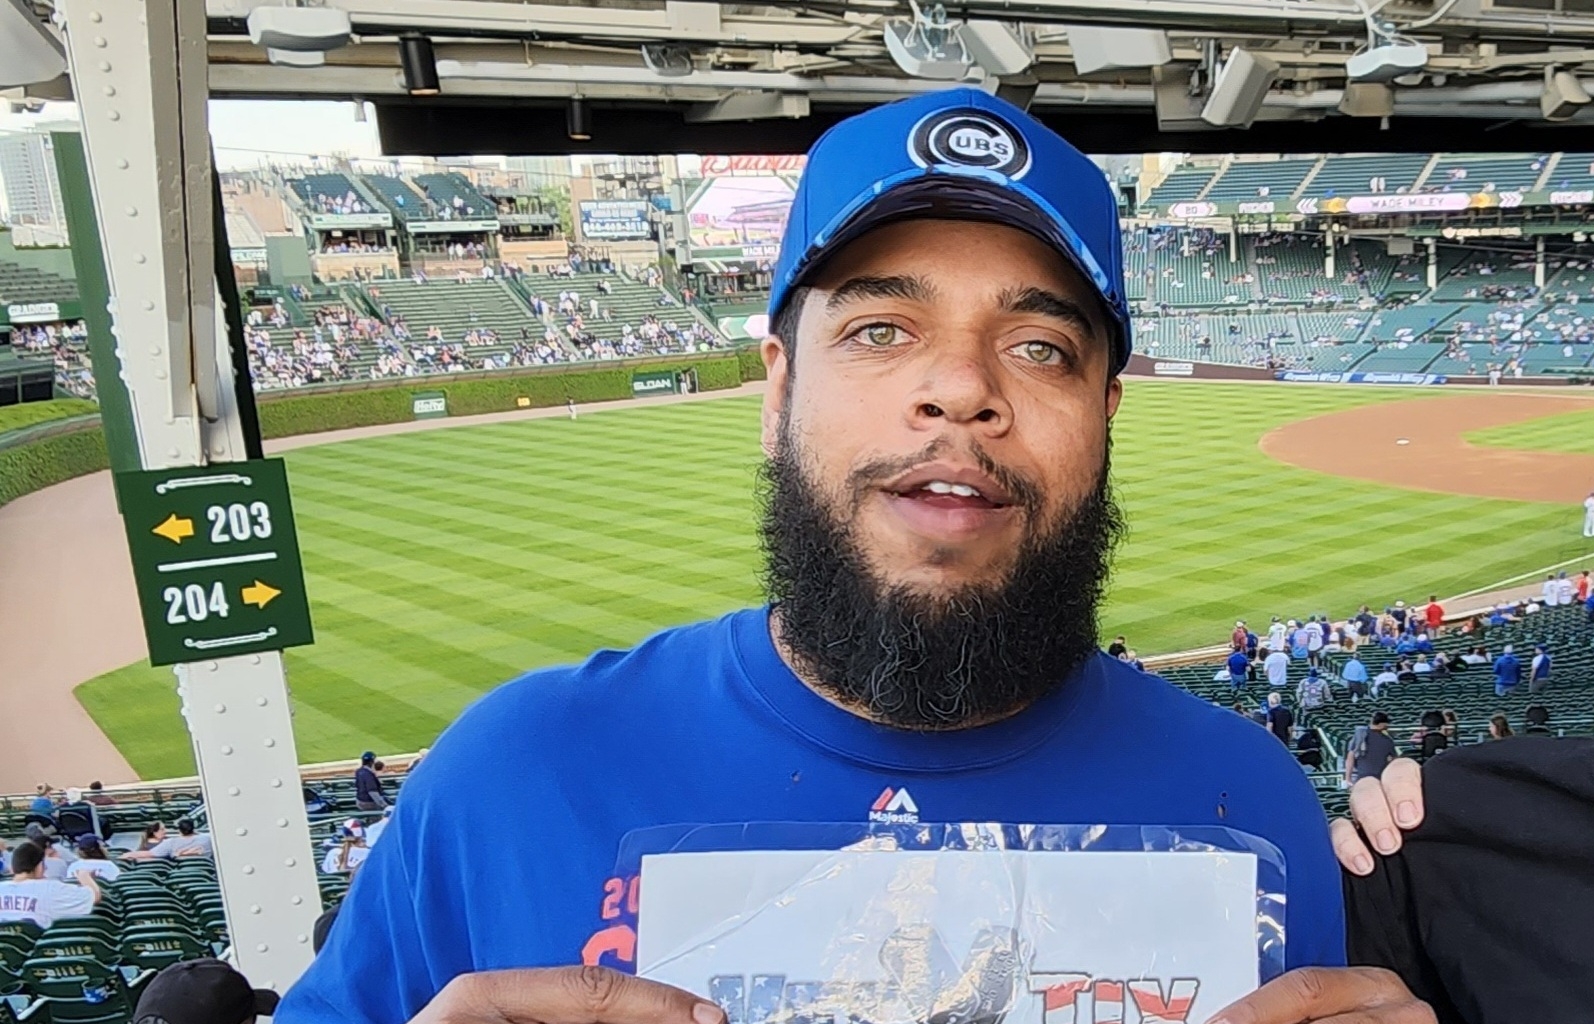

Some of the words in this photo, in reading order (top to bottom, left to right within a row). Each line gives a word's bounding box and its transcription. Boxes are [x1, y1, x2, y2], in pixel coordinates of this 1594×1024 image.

[206, 500, 273, 544] 203
[163, 580, 230, 625] 204
[868, 810, 919, 826] Majestic
